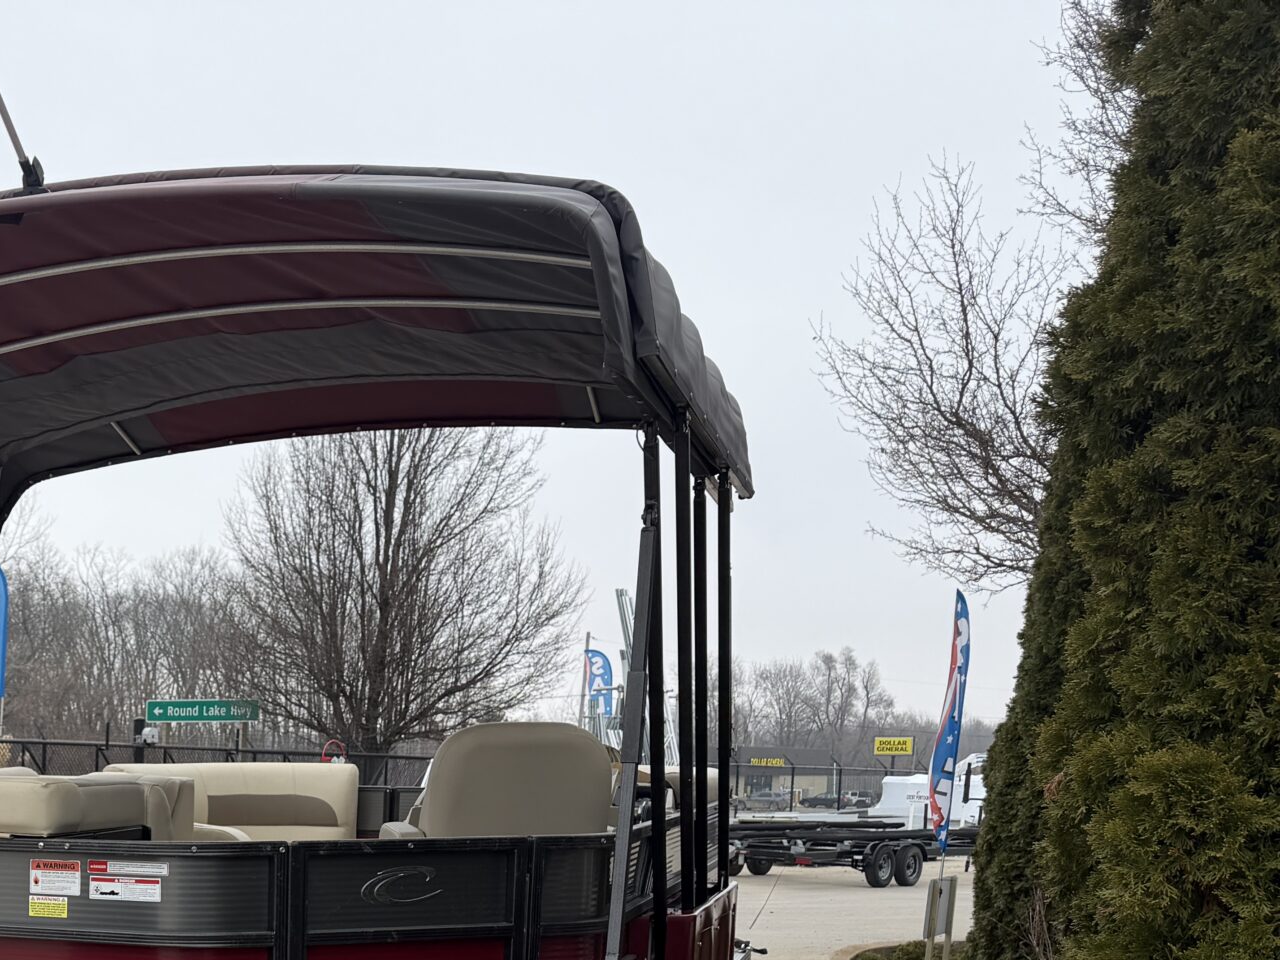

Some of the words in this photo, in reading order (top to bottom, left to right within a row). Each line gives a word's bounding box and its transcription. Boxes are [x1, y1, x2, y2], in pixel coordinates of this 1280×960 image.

[167, 705, 199, 716] Round
[203, 705, 226, 716] Lake
[231, 705, 252, 718] Hwy
